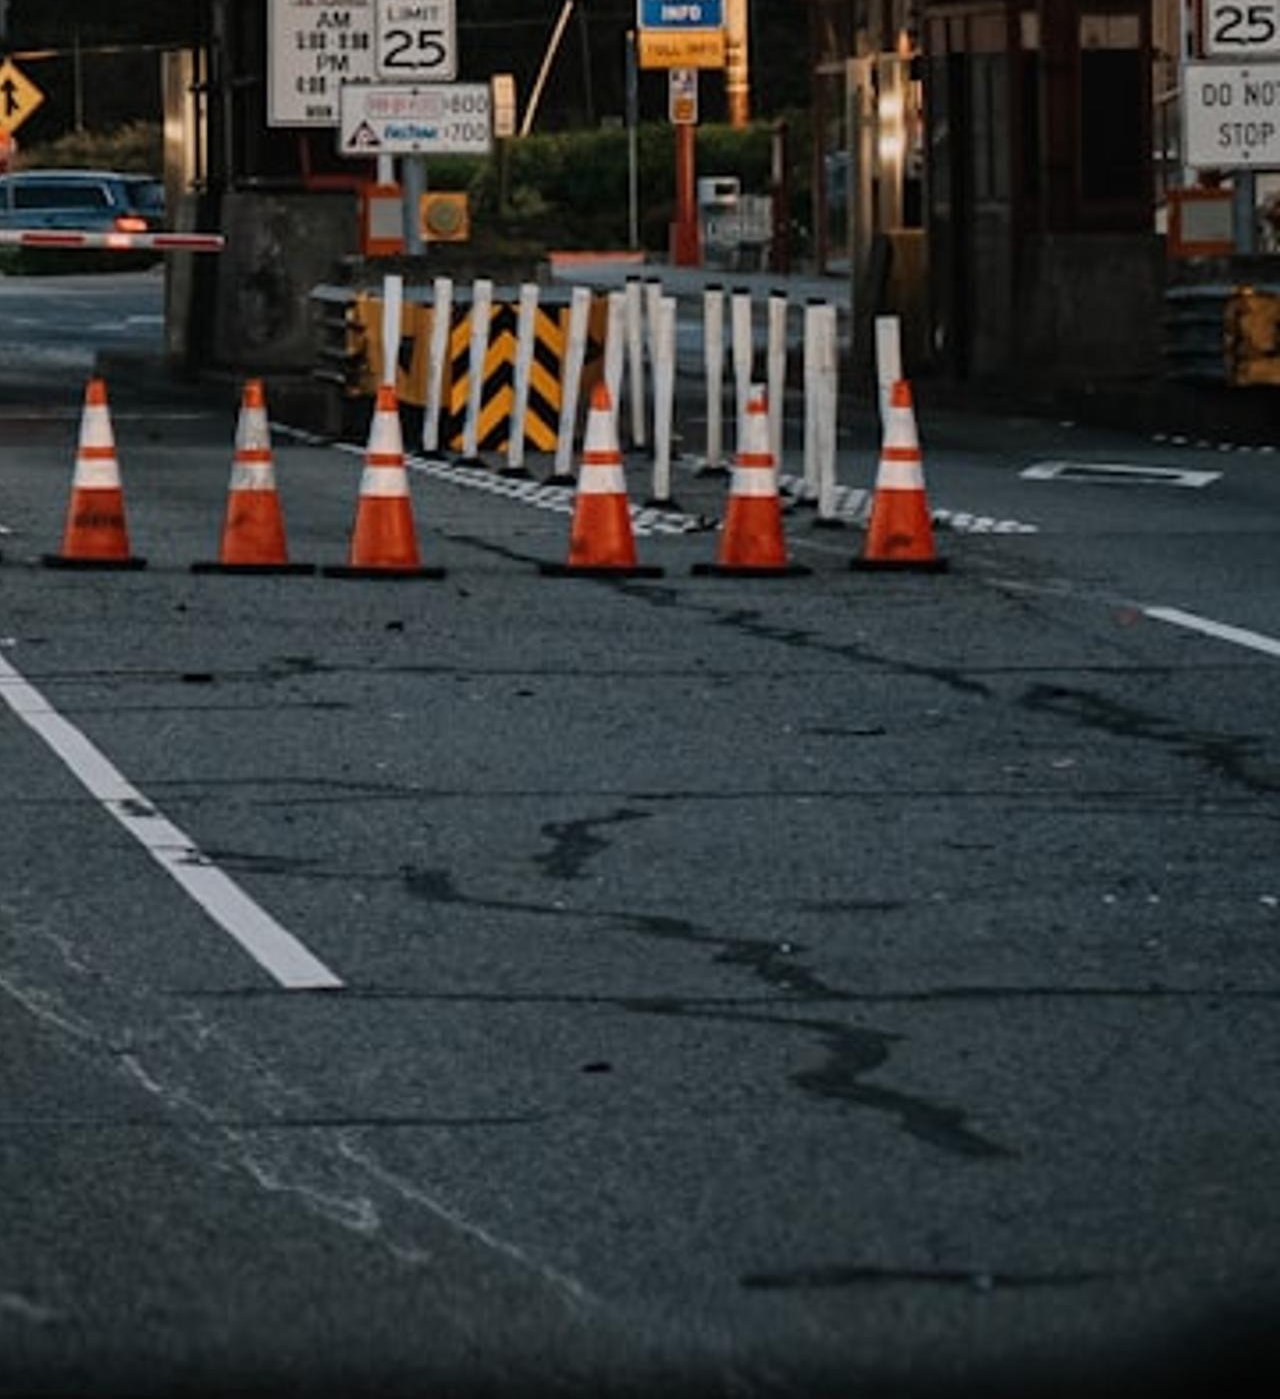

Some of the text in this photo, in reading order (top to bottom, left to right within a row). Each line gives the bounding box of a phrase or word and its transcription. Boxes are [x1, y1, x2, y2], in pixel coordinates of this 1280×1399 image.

[316, 11, 352, 29] AM
[387, 6, 440, 22] LIMIT
[661, 4, 703, 21] INFO
[1214, 5, 1276, 45] 25
[382, 29, 447, 68] 25
[316, 54, 351, 72] PM
[1201, 83, 1232, 107] DO
[1217, 122, 1275, 148] STOP
